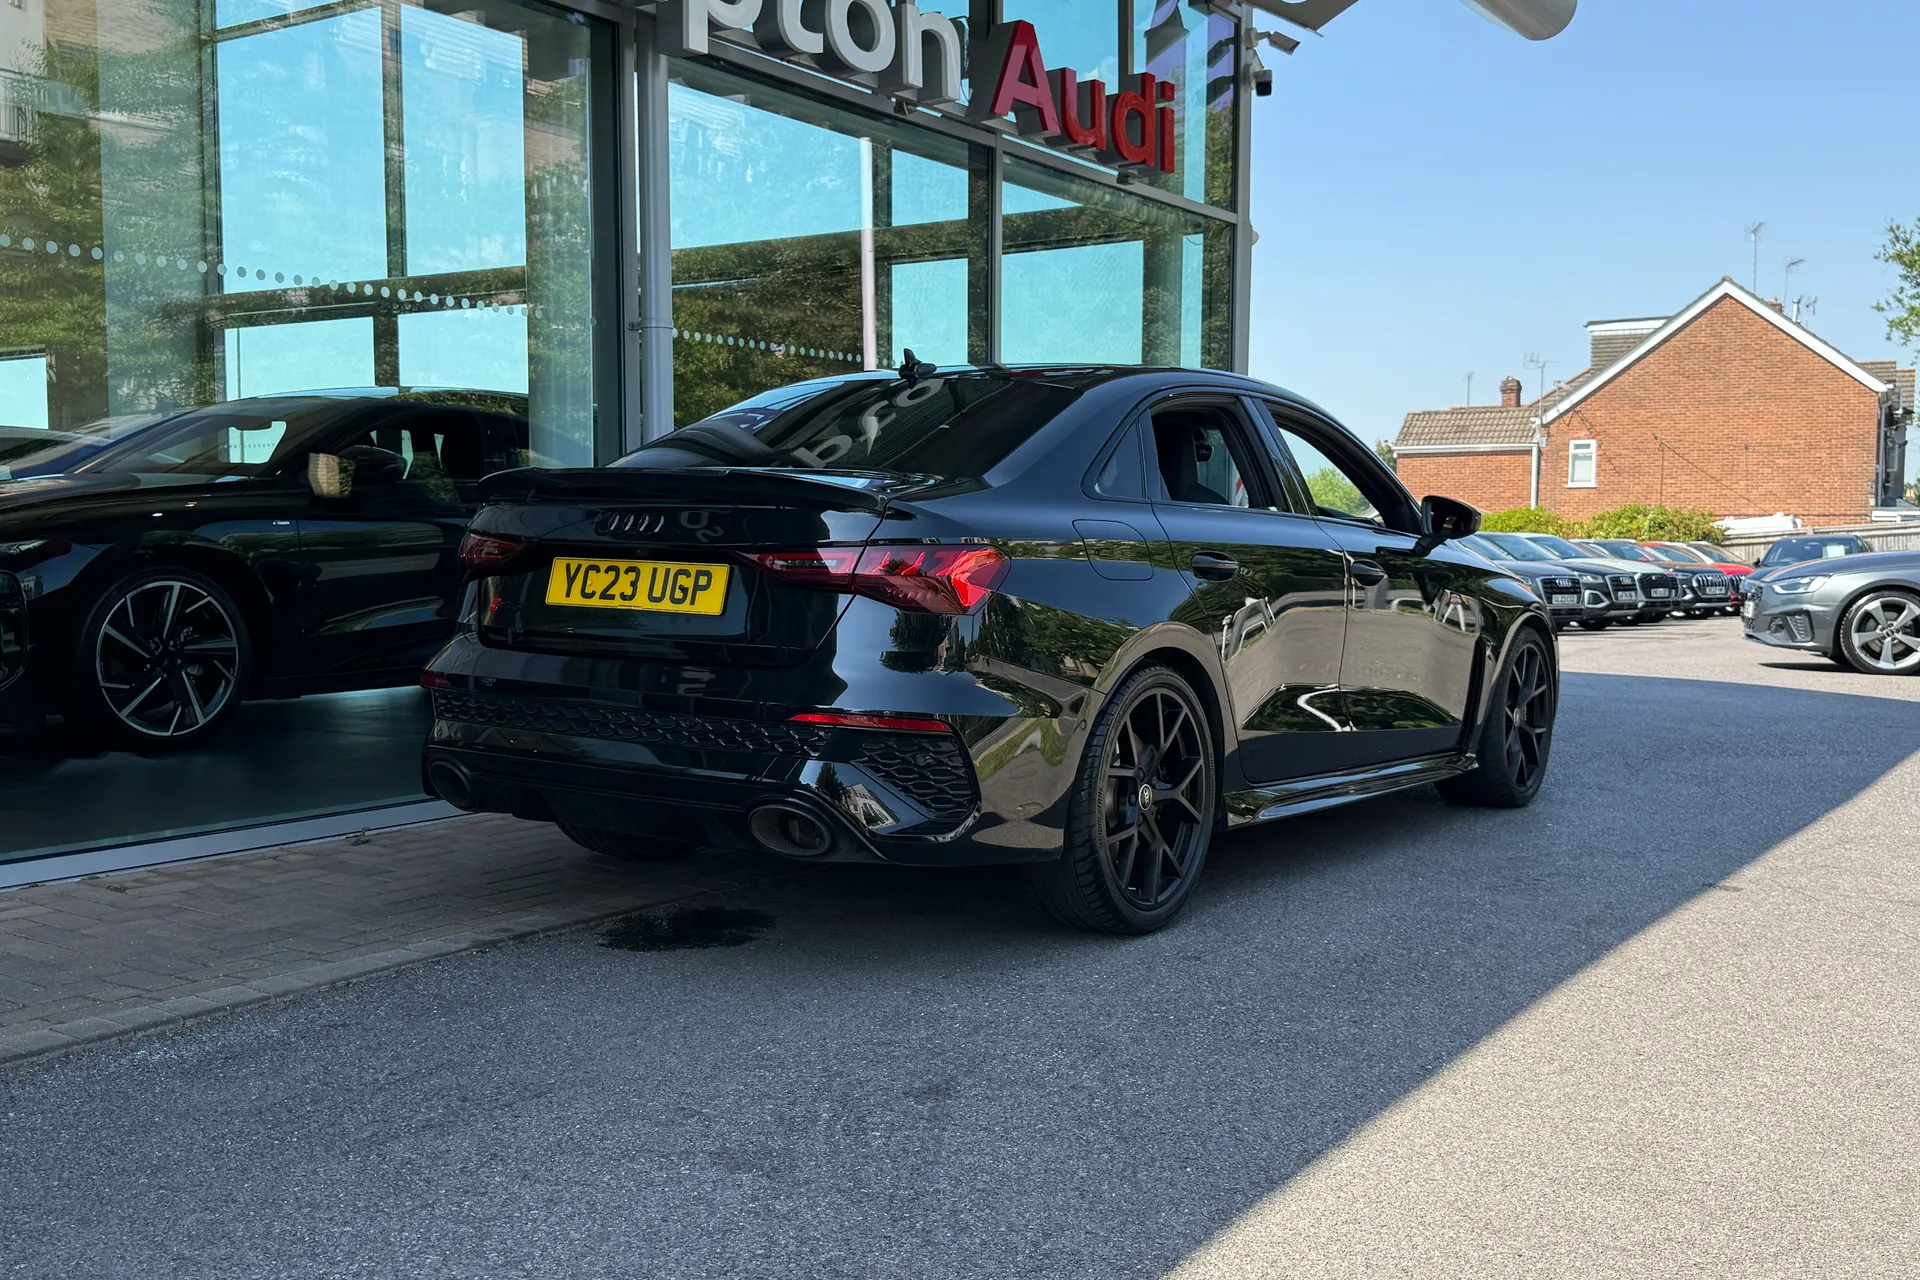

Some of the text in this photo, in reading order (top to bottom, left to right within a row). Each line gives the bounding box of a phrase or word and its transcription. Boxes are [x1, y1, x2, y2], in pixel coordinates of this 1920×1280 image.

[989, 19, 1175, 173] Audi
[565, 562, 713, 606] YC23 UGP
